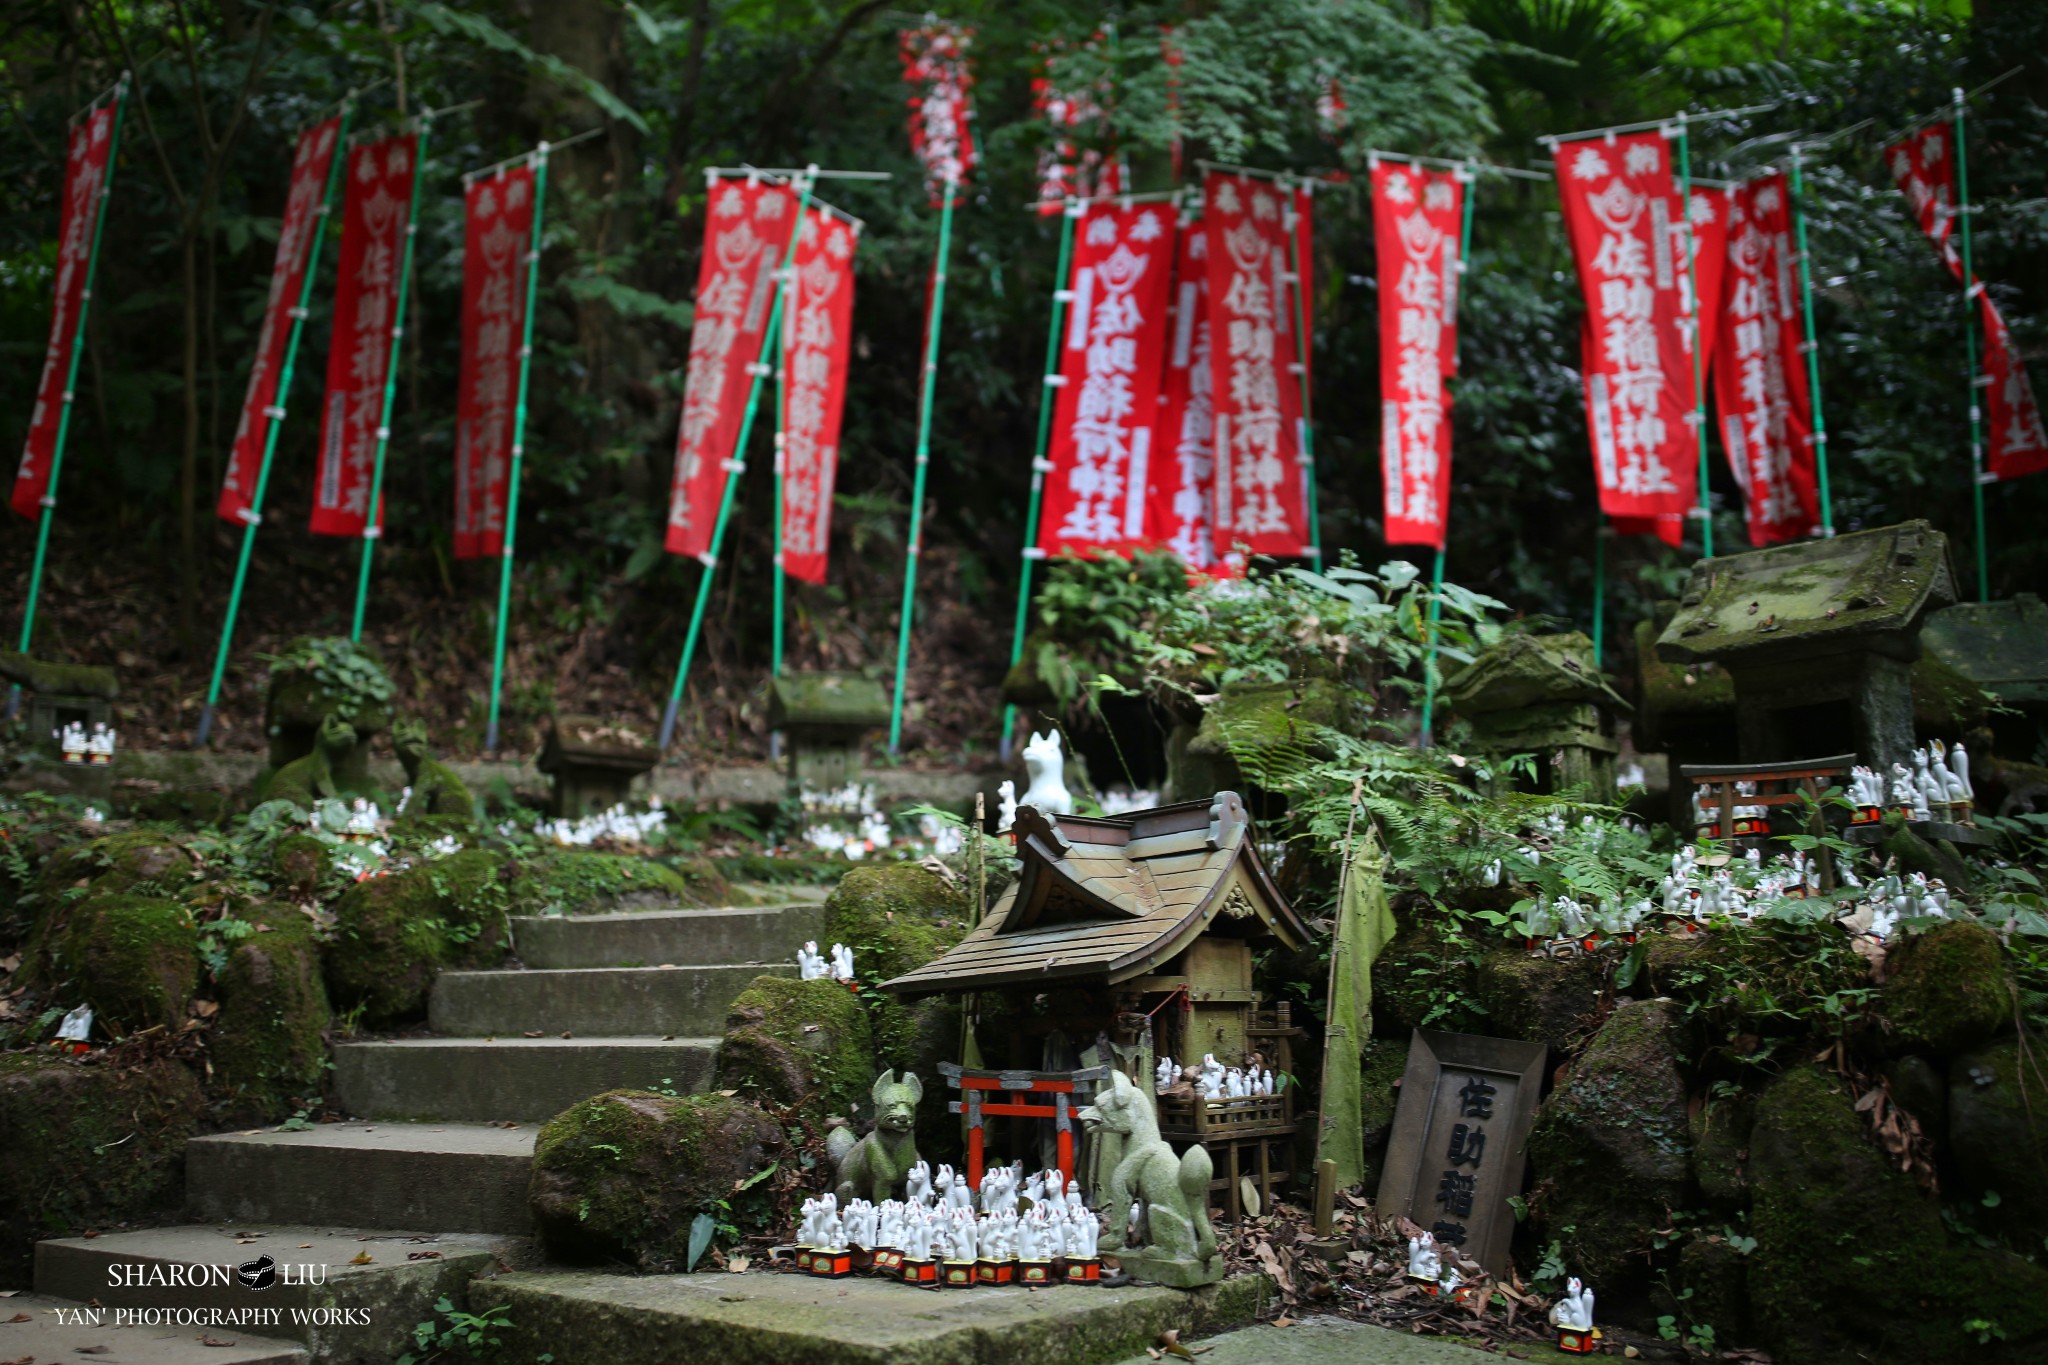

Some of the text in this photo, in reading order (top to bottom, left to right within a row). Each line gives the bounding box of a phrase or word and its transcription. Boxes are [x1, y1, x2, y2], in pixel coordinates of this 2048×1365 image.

[1570, 142, 1661, 181] 奉納
[1221, 270, 1291, 536] 佐助稲荷神社
[1591, 231, 1680, 496] 佐助稲荷神社
